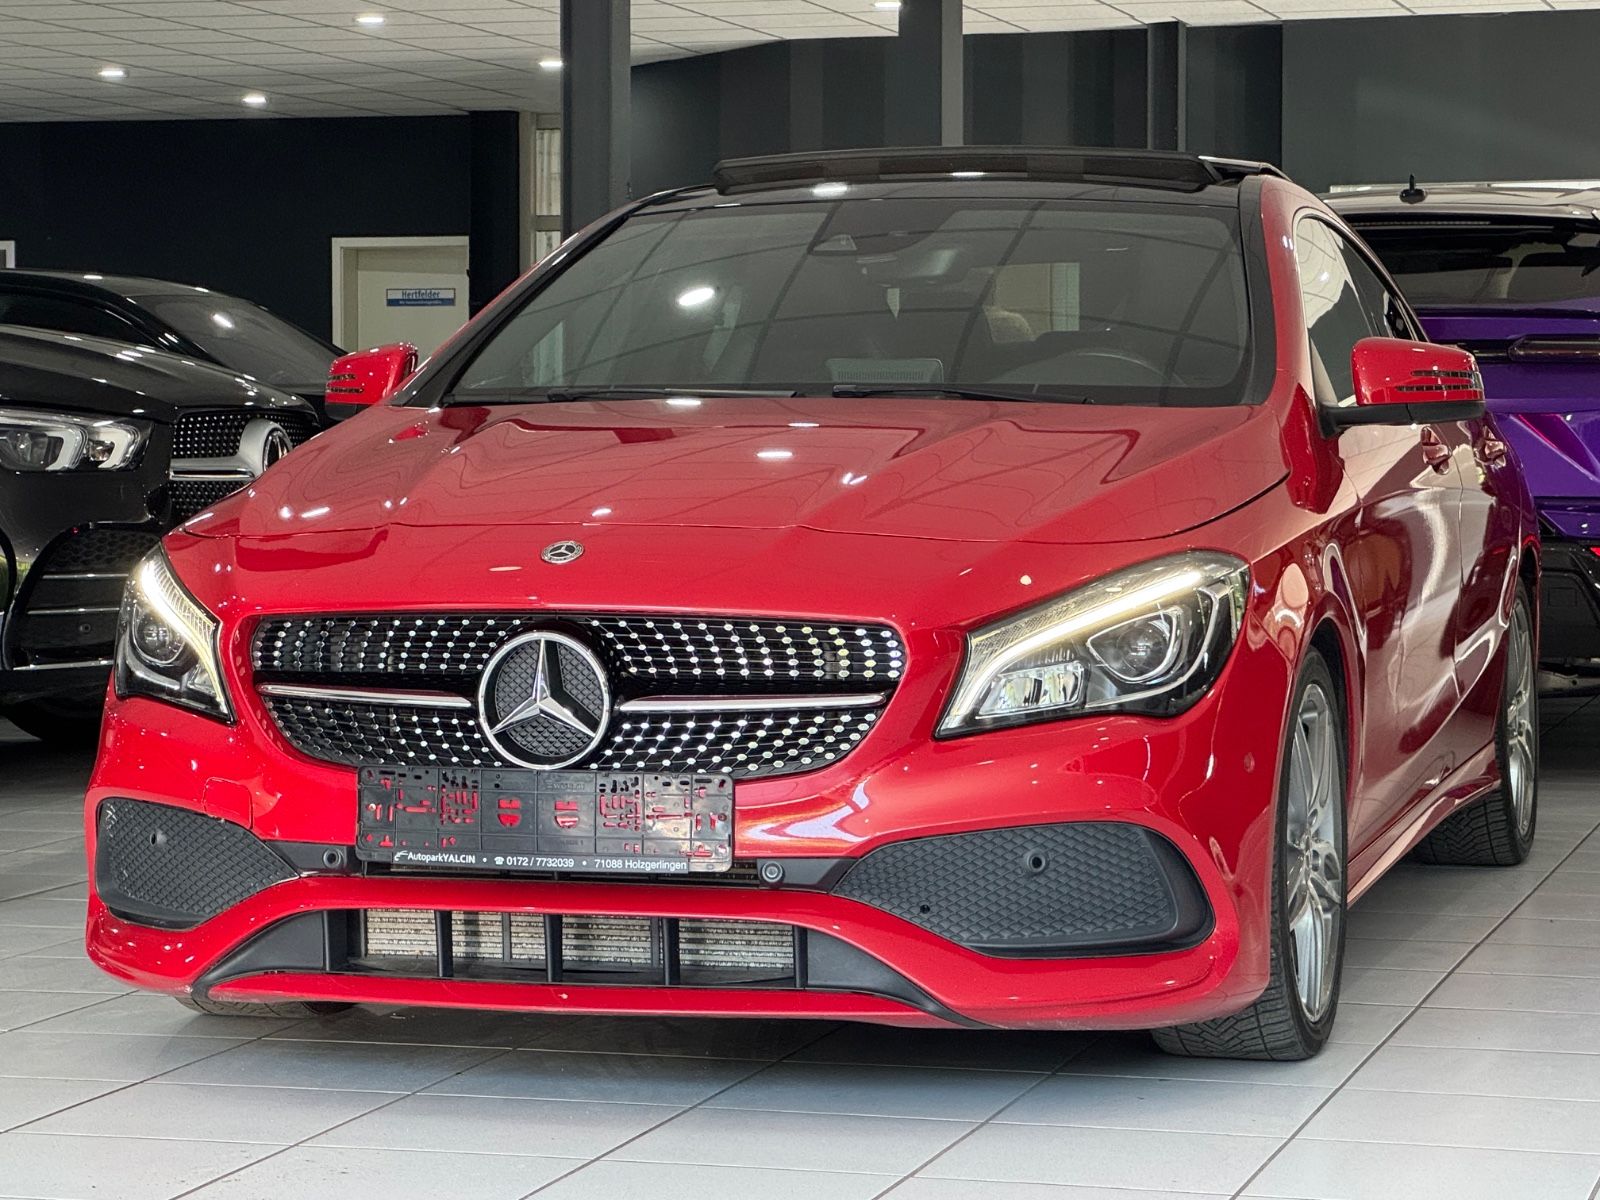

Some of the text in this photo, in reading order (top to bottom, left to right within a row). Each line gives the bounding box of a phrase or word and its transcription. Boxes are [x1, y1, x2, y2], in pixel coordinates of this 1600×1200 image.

[401, 290, 441, 299] Hertfelder
[407, 852, 475, 863] AutoparkYALCIN
[506, 856, 528, 866] 0172
[535, 857, 574, 867] 7732039
[594, 859, 623, 868] 71088
[625, 859, 687, 871] Holzgerlingen
